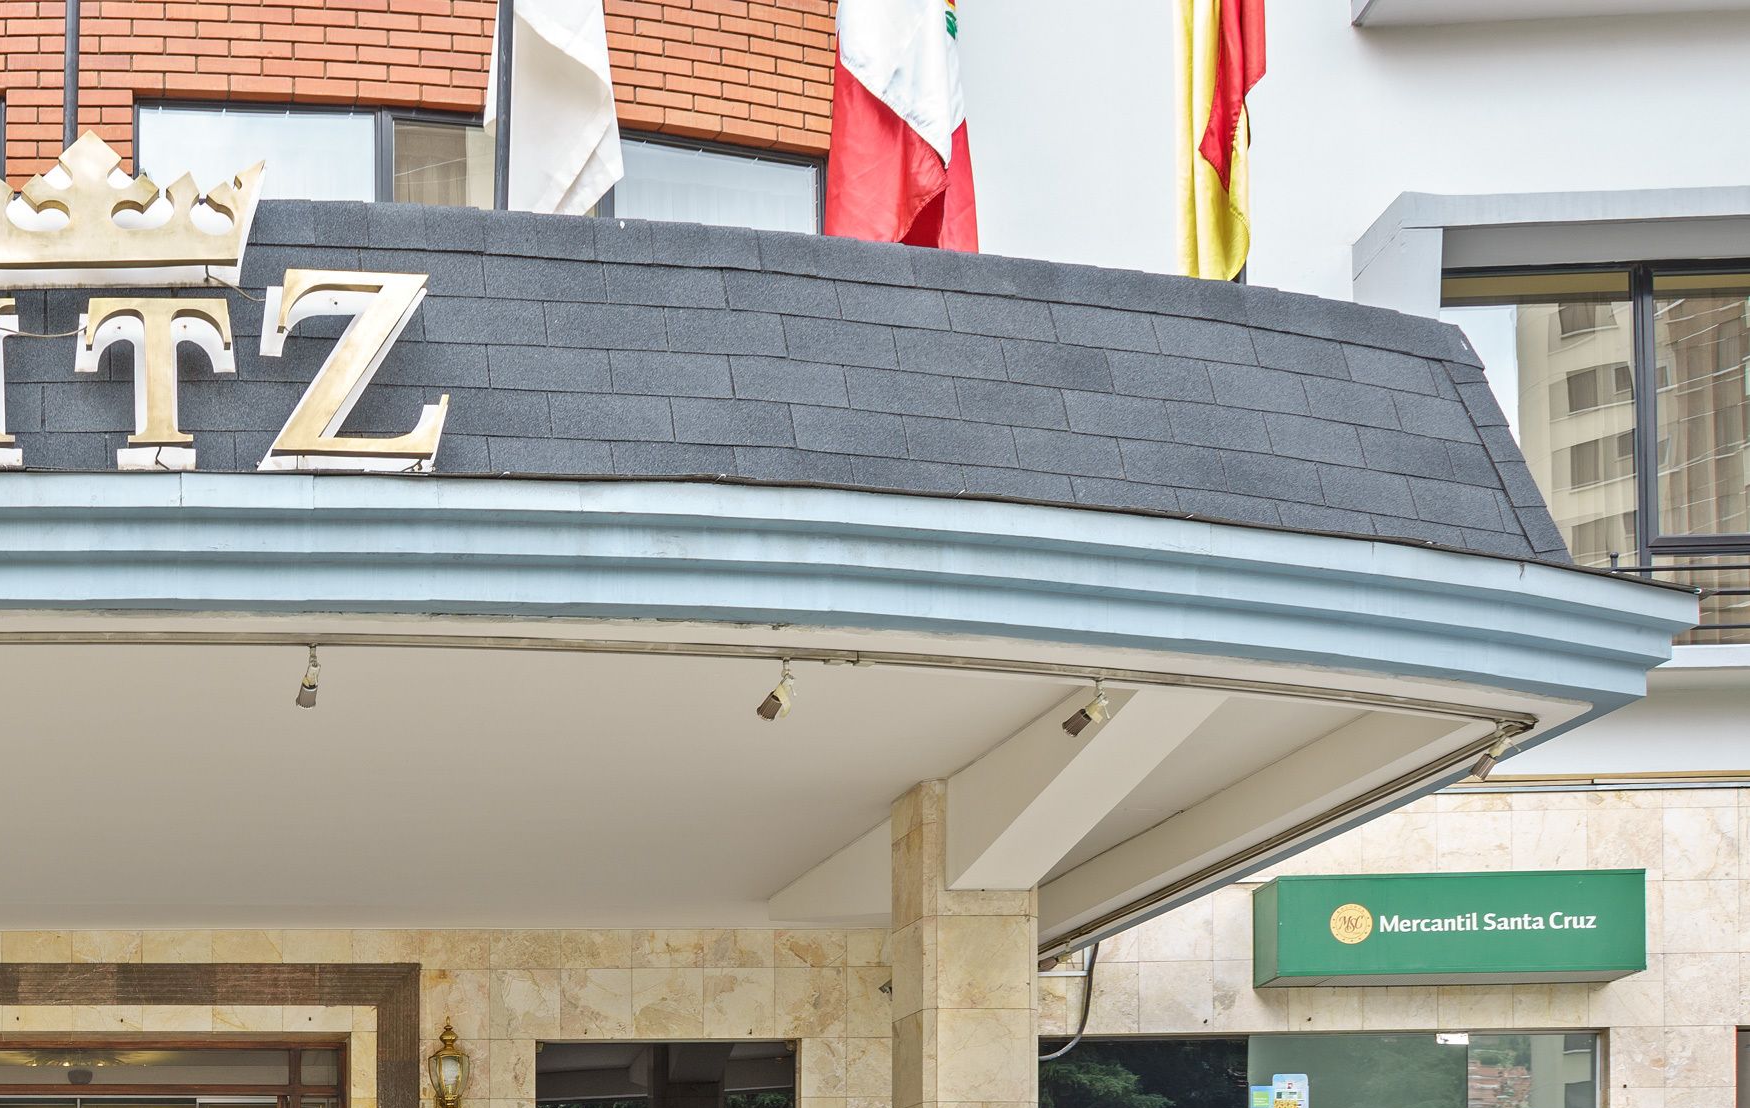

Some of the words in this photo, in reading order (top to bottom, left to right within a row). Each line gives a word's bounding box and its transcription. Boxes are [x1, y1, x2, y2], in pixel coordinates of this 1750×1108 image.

[1379, 911, 1479, 933] Mercantil
[1482, 911, 1546, 931] Santa
[1549, 910, 1597, 929] Cruz
